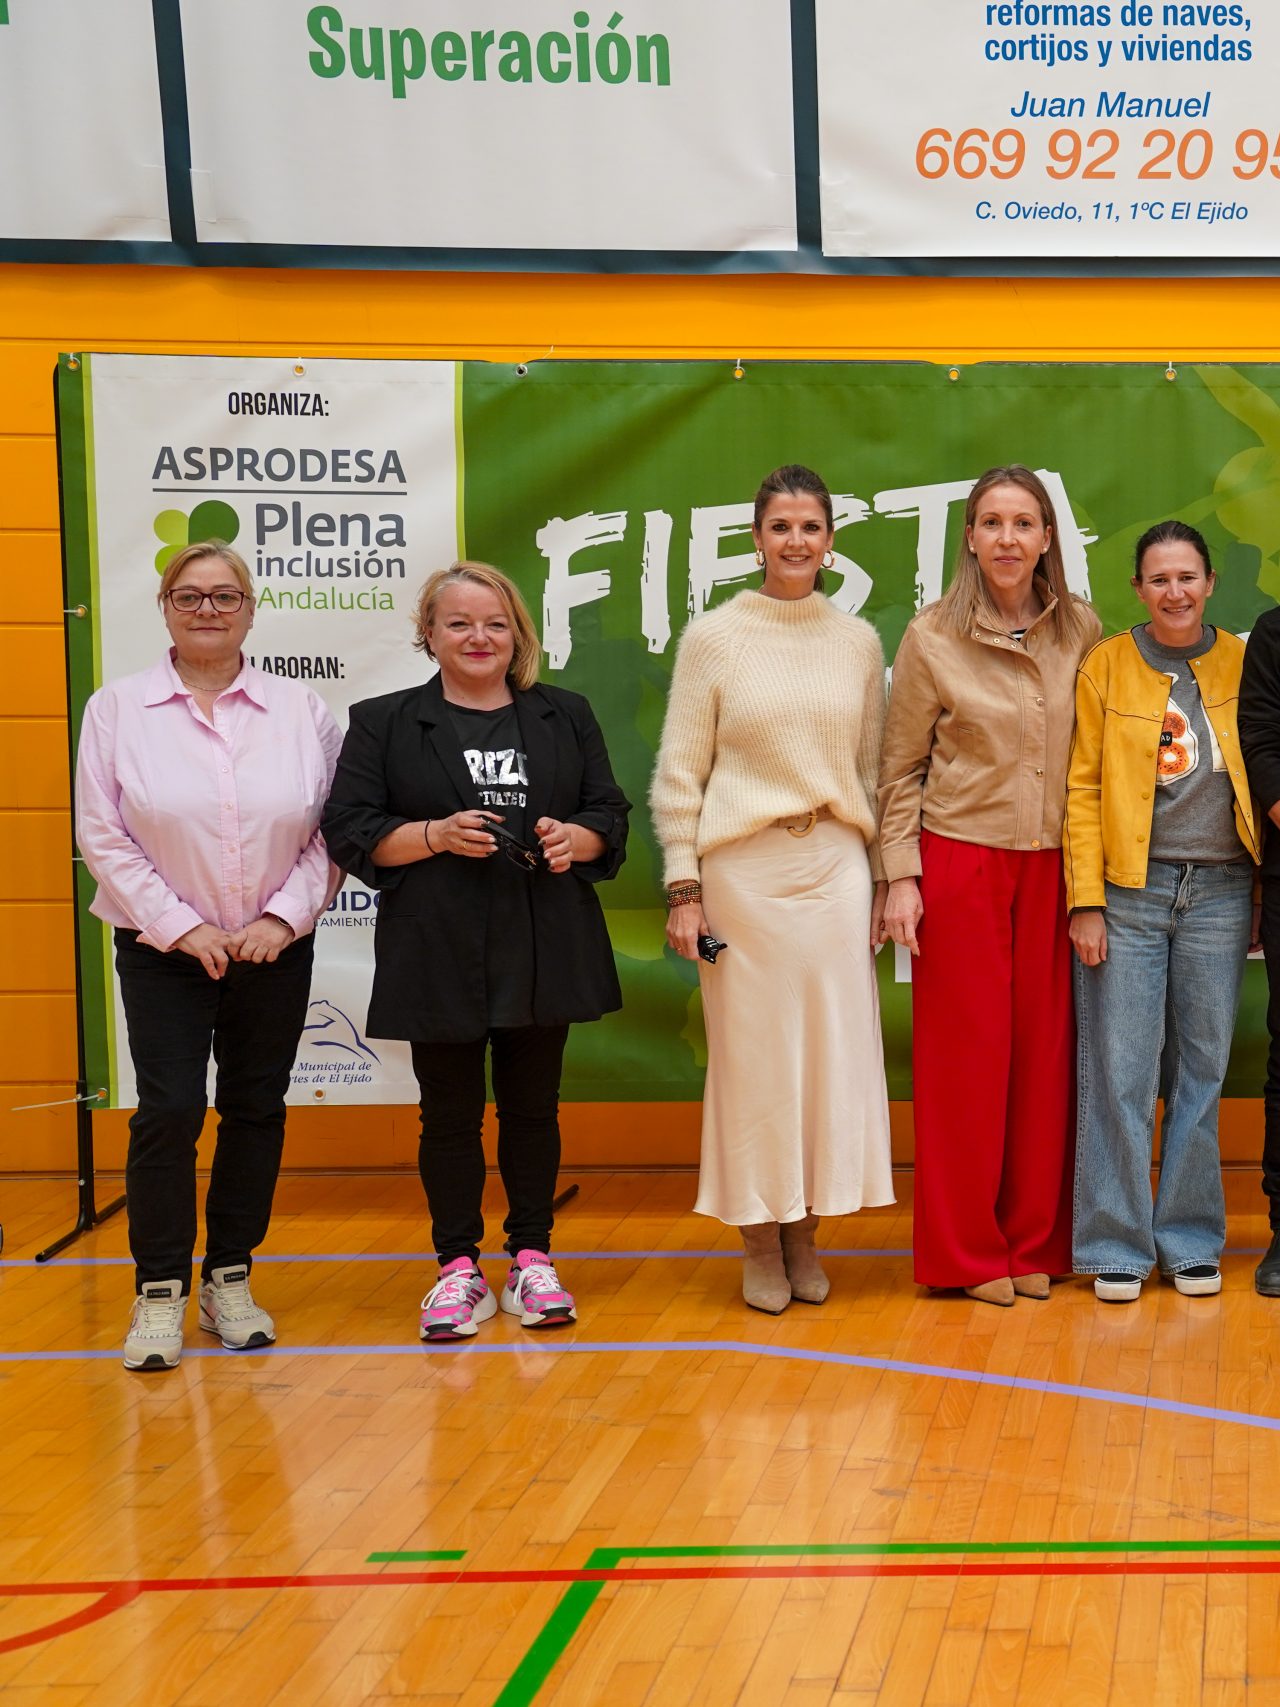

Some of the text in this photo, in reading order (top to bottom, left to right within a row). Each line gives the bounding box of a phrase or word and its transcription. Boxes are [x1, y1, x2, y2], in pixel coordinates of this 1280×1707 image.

[986, 0, 1251, 31] reformas de naves,
[306, 5, 672, 99] Superación
[984, 34, 1252, 67] cortijos y viviendas
[1010, 91, 1211, 118] Juan Manuel
[916, 127, 1026, 180] 669
[1045, 128, 1120, 180] 92
[1137, 128, 1214, 180] 20
[975, 201, 1248, 224] C. Oviedo, 11, 1ºC El Ejido
[228, 391, 329, 417] ORGANIZA:
[152, 446, 407, 484] ASPRODESA
[255, 501, 407, 548] Plena
[255, 550, 406, 579] inclusión
[256, 586, 395, 611] Andalucía
[247, 655, 345, 679] ABORAN:
[478, 791, 527, 808] IVATED
[298, 1061, 372, 1073] Municipal de
[312, 1073, 326, 1083] de
[329, 1073, 340, 1083] El
[343, 1073, 372, 1086] Ejido
